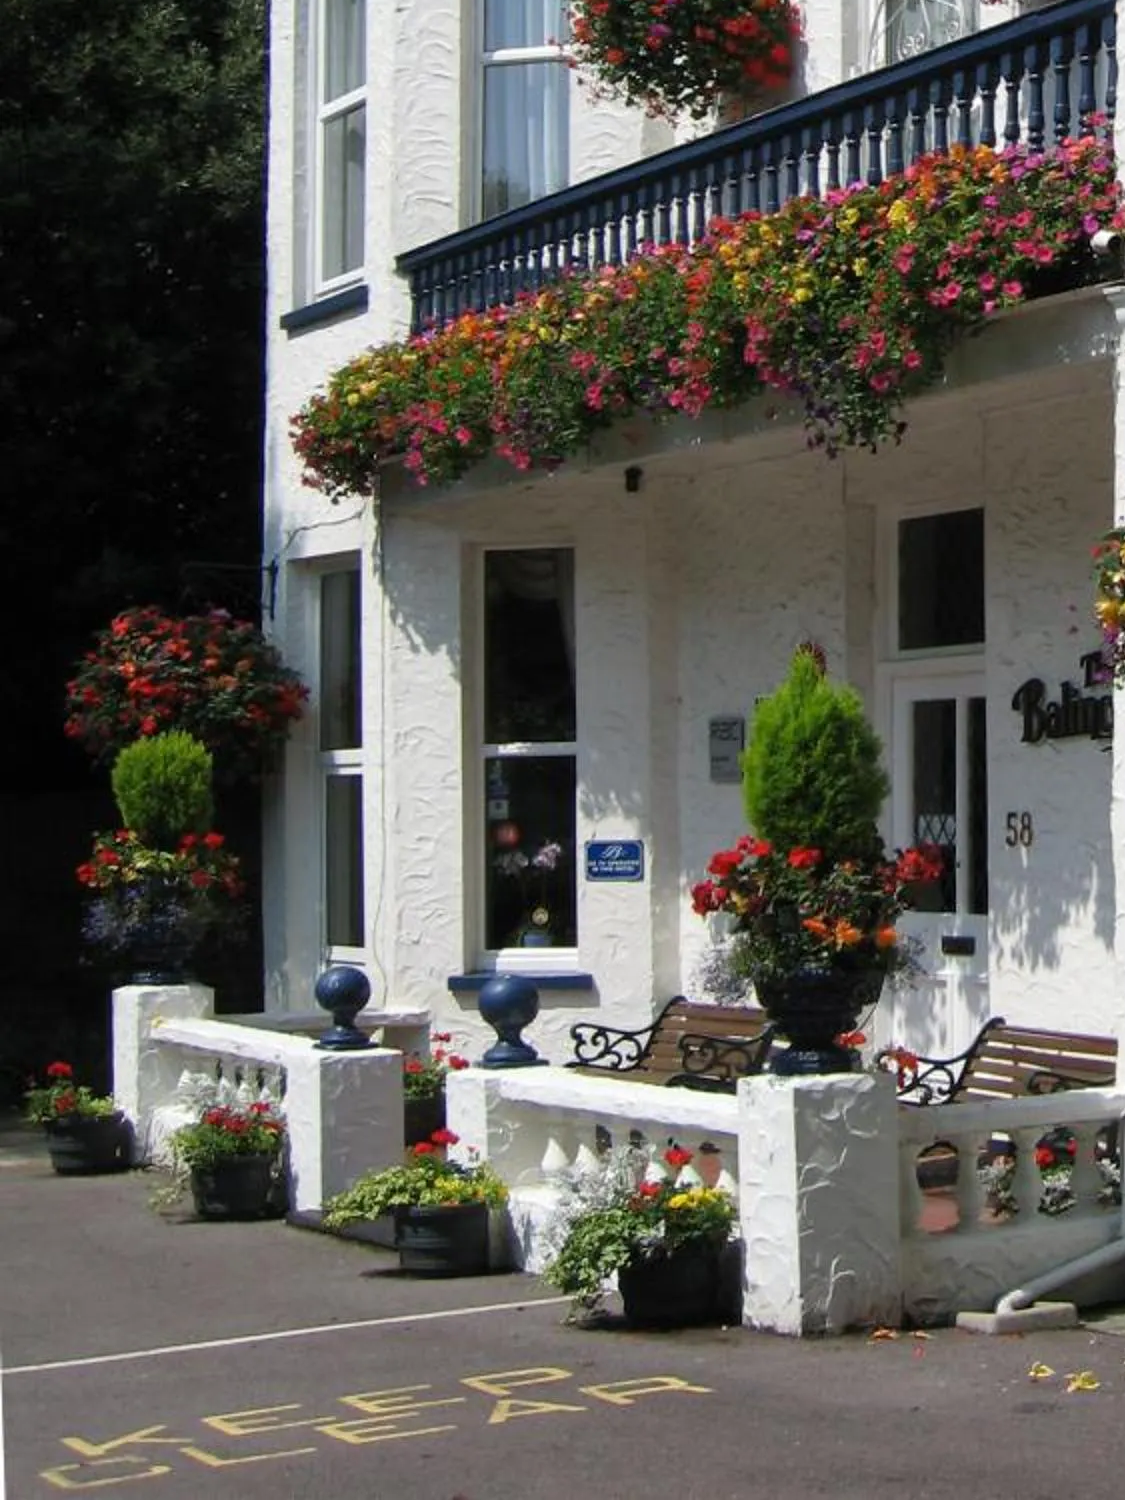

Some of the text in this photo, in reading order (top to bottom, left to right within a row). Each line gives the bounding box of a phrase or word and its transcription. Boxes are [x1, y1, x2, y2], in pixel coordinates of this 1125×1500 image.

[1005, 811, 1034, 847] 58
[40, 1376, 716, 1488] CLEAR
[60, 1367, 575, 1456] KEEP
